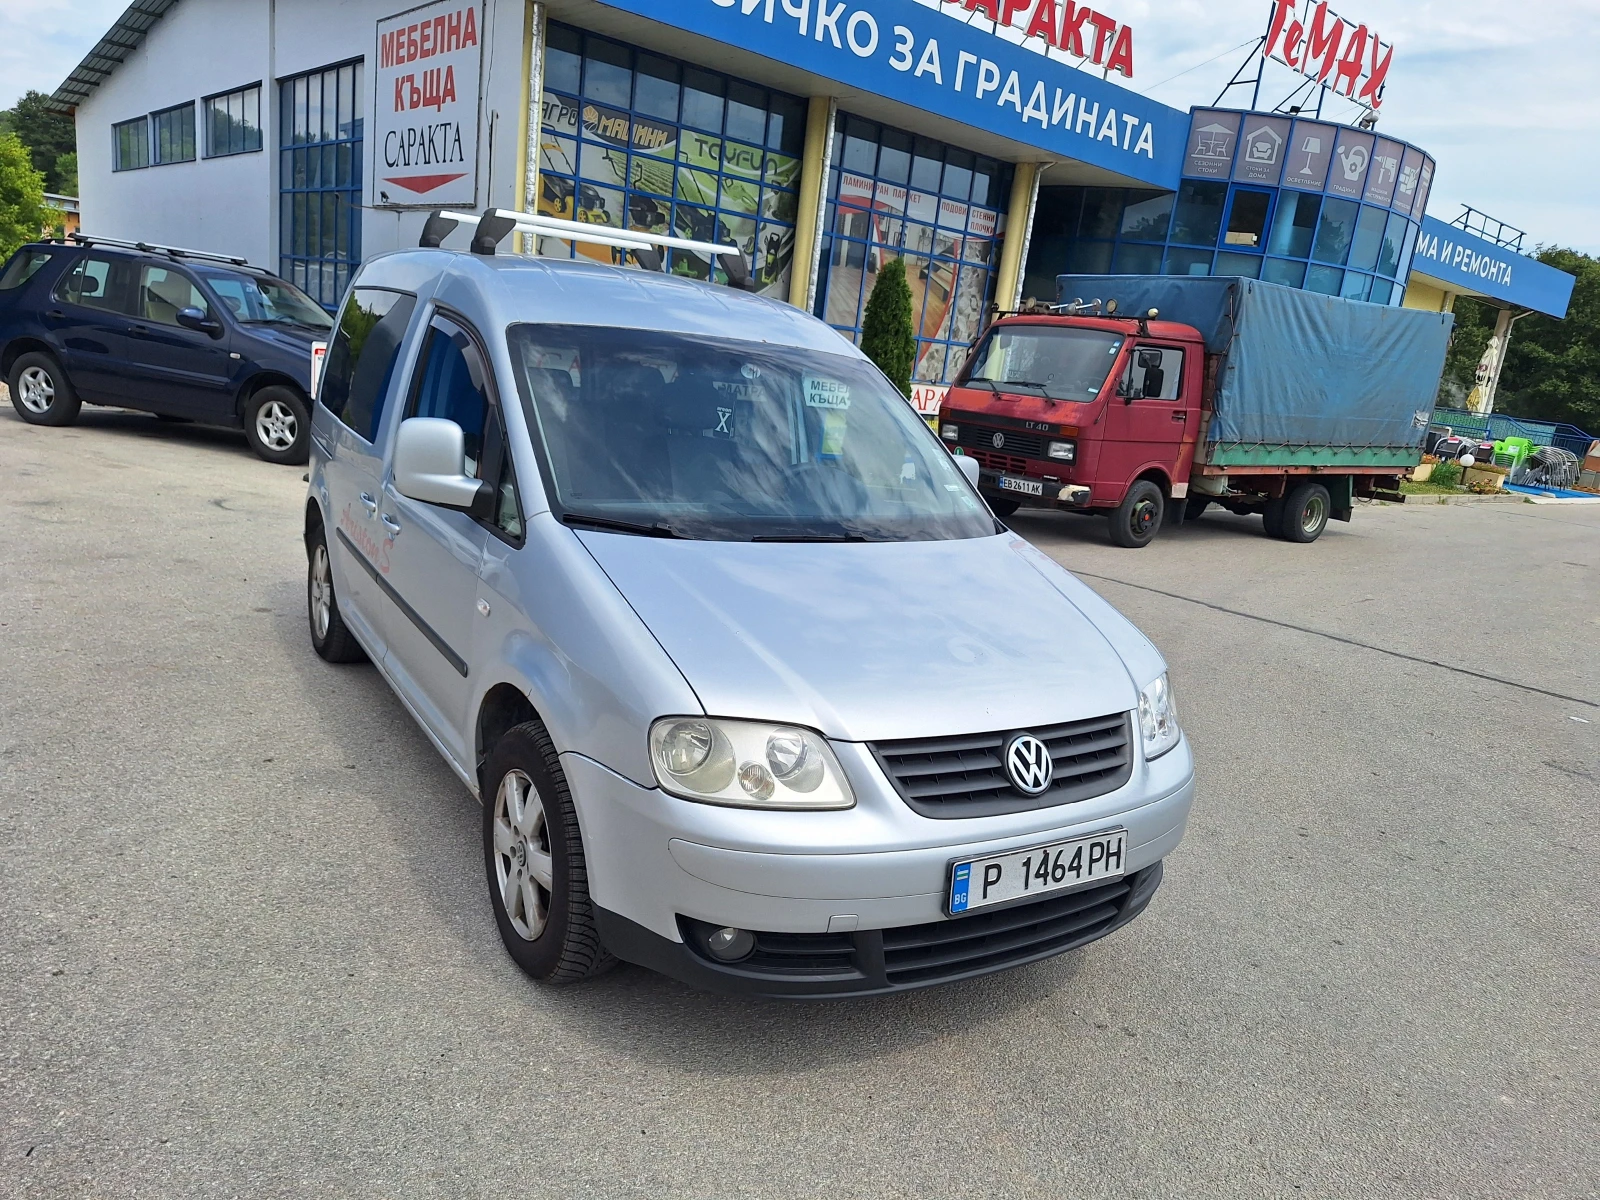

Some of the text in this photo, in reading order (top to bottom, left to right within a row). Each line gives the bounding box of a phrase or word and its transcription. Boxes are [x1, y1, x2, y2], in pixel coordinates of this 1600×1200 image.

[381, 6, 477, 69] МЕБЕЛНА
[942, 0, 1134, 78] РАКТА
[394, 65, 456, 113] КЪЩА
[711, 0, 1154, 160] ЧКО ЗА ГРАДИНАТА
[597, 114, 668, 148] МАШИНИ
[384, 120, 464, 168] САРАКТА
[1194, 160, 1223, 168] СЕЗОННИ
[1248, 171, 1267, 179] ДОМА
[1286, 176, 1322, 187] ОСВЕТЛЕНИЕ
[842, 175, 922, 204] ЛАМИНИРАН ПАРКЕТ
[1333, 184, 1356, 194] ГРАДИНА
[941, 202, 995, 223] ПОДОВИ СТЕННИ
[970, 222, 995, 235] ПЛОЧКИ
[1440, 239, 1453, 264] И
[1453, 245, 1512, 287] РЕМОНТА
[809, 392, 847, 406] КЪЩА
[715, 410, 731, 433] X
[1025, 421, 1049, 431] LT 40
[1013, 480, 1030, 492] 2611
[954, 891, 967, 906] BG
